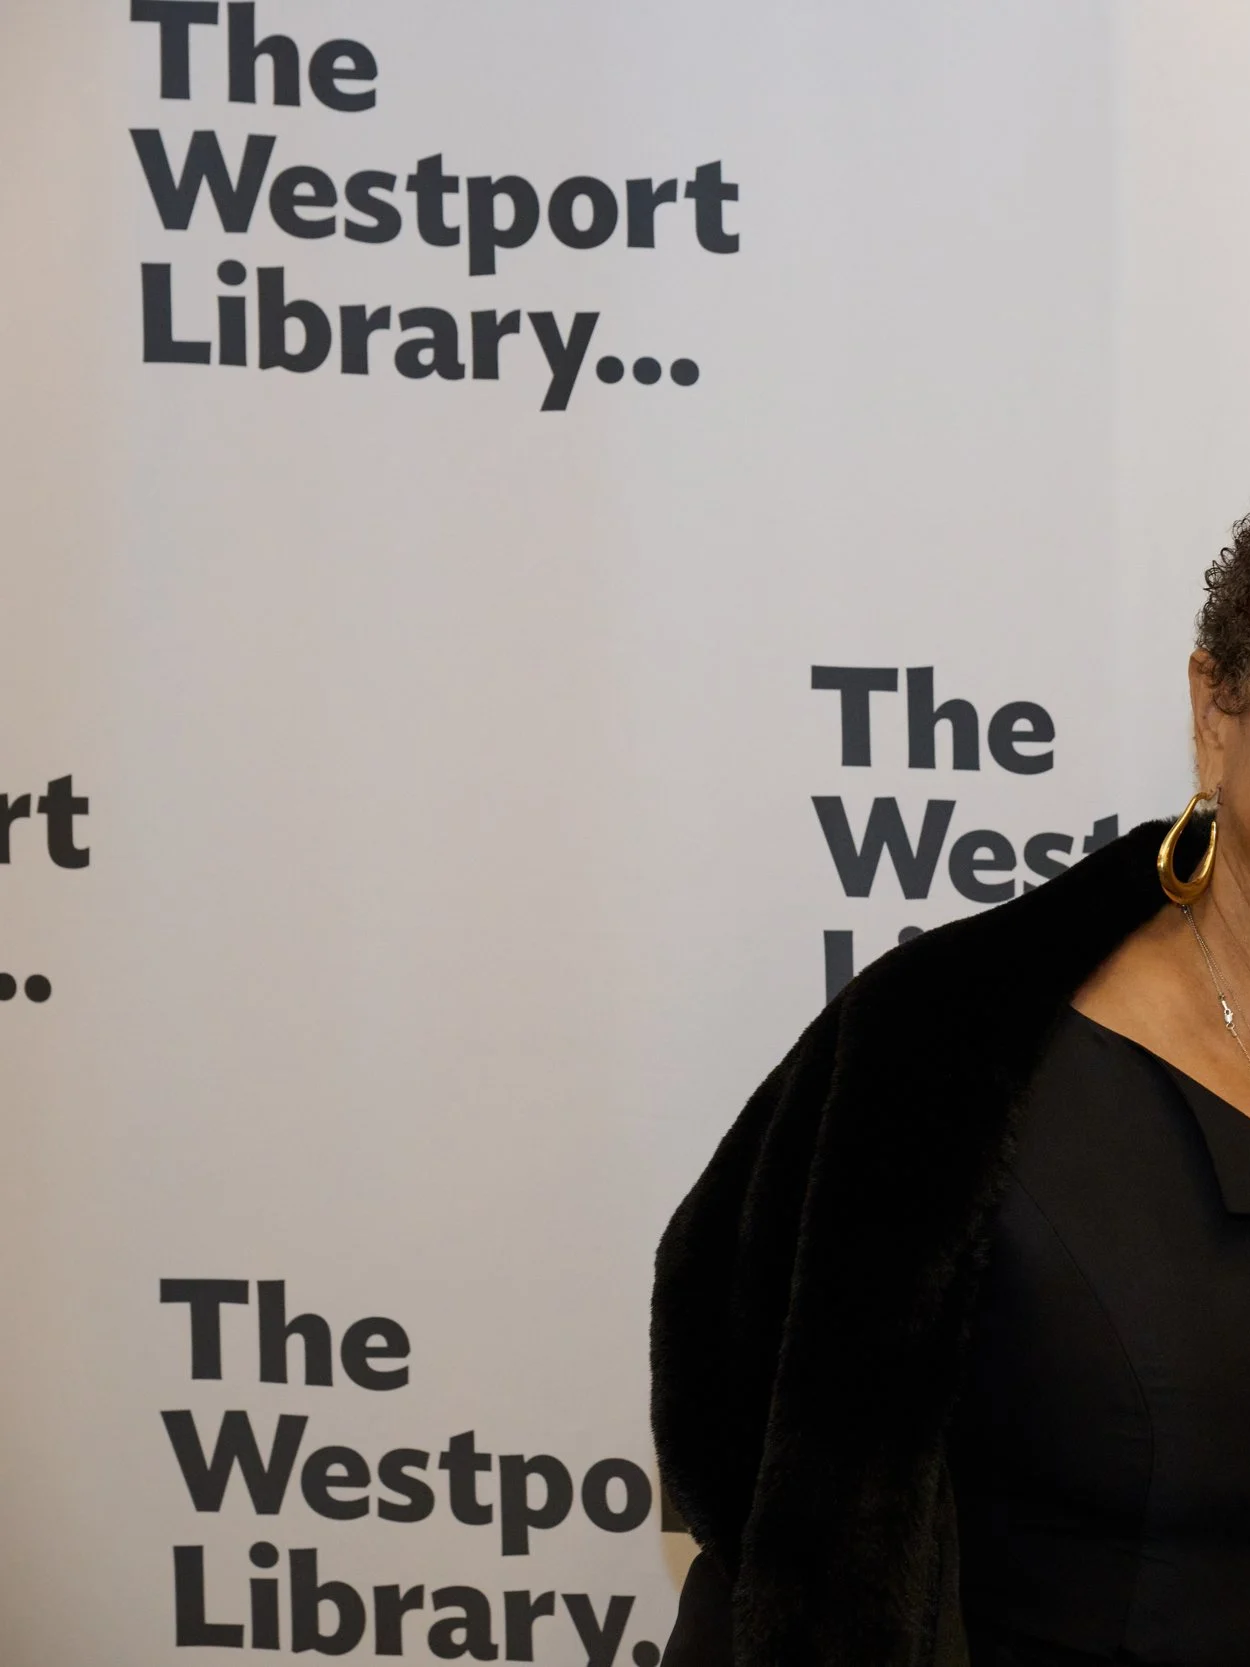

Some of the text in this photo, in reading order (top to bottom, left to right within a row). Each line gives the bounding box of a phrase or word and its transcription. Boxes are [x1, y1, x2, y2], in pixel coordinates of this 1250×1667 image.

[131, 0, 378, 112] The
[129, 128, 740, 277] Westport
[141, 259, 700, 412] Library...
[811, 665, 1055, 775] The
[159, 1278, 411, 1392] The
[160, 1409, 690, 1557] Westpo
